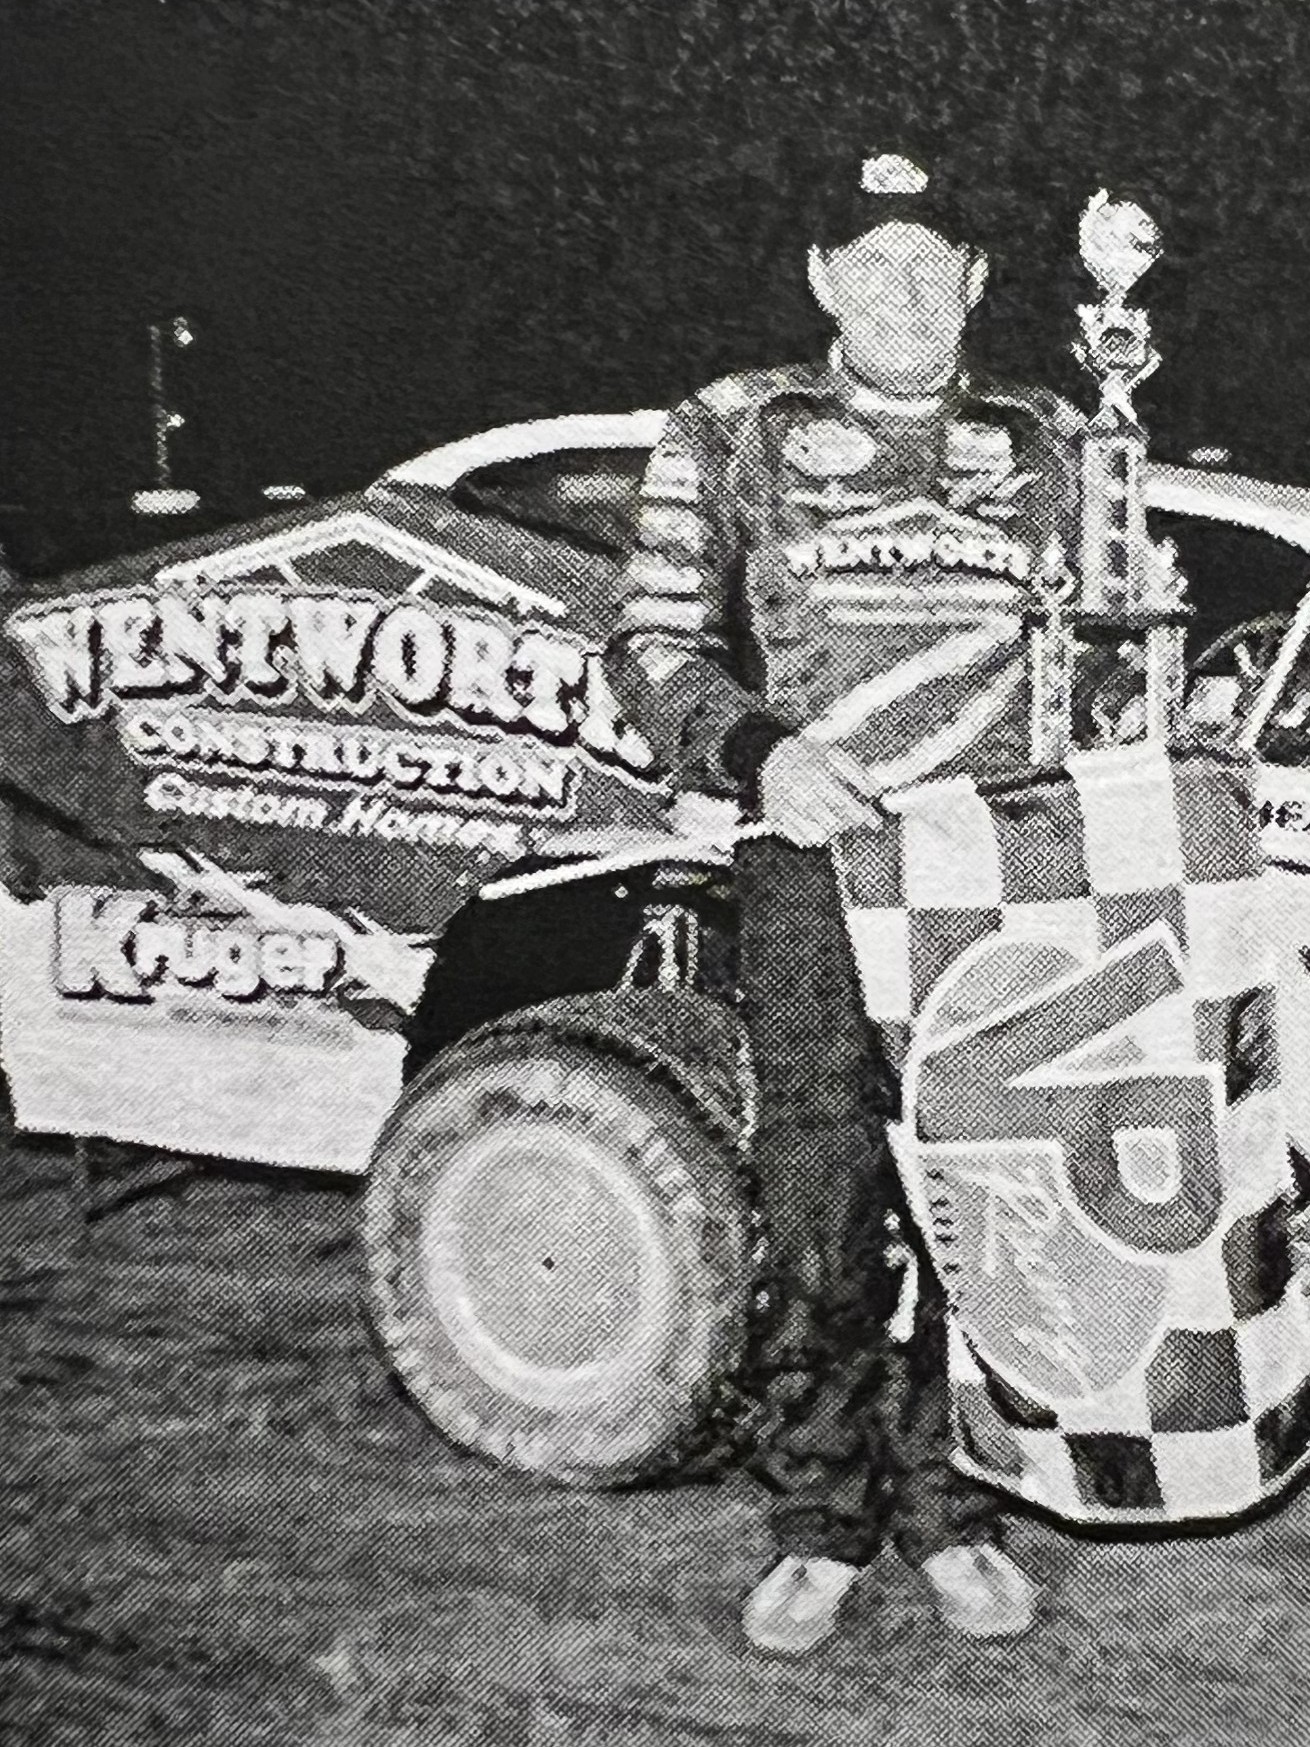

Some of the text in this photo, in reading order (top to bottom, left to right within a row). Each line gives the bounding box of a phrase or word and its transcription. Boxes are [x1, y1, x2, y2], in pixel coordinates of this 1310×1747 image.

[126, 712, 572, 803] CONSTRUCTION
[144, 771, 328, 830] Custom
[57, 892, 345, 1003] Kruger
[915, 932, 1226, 1256] VP
